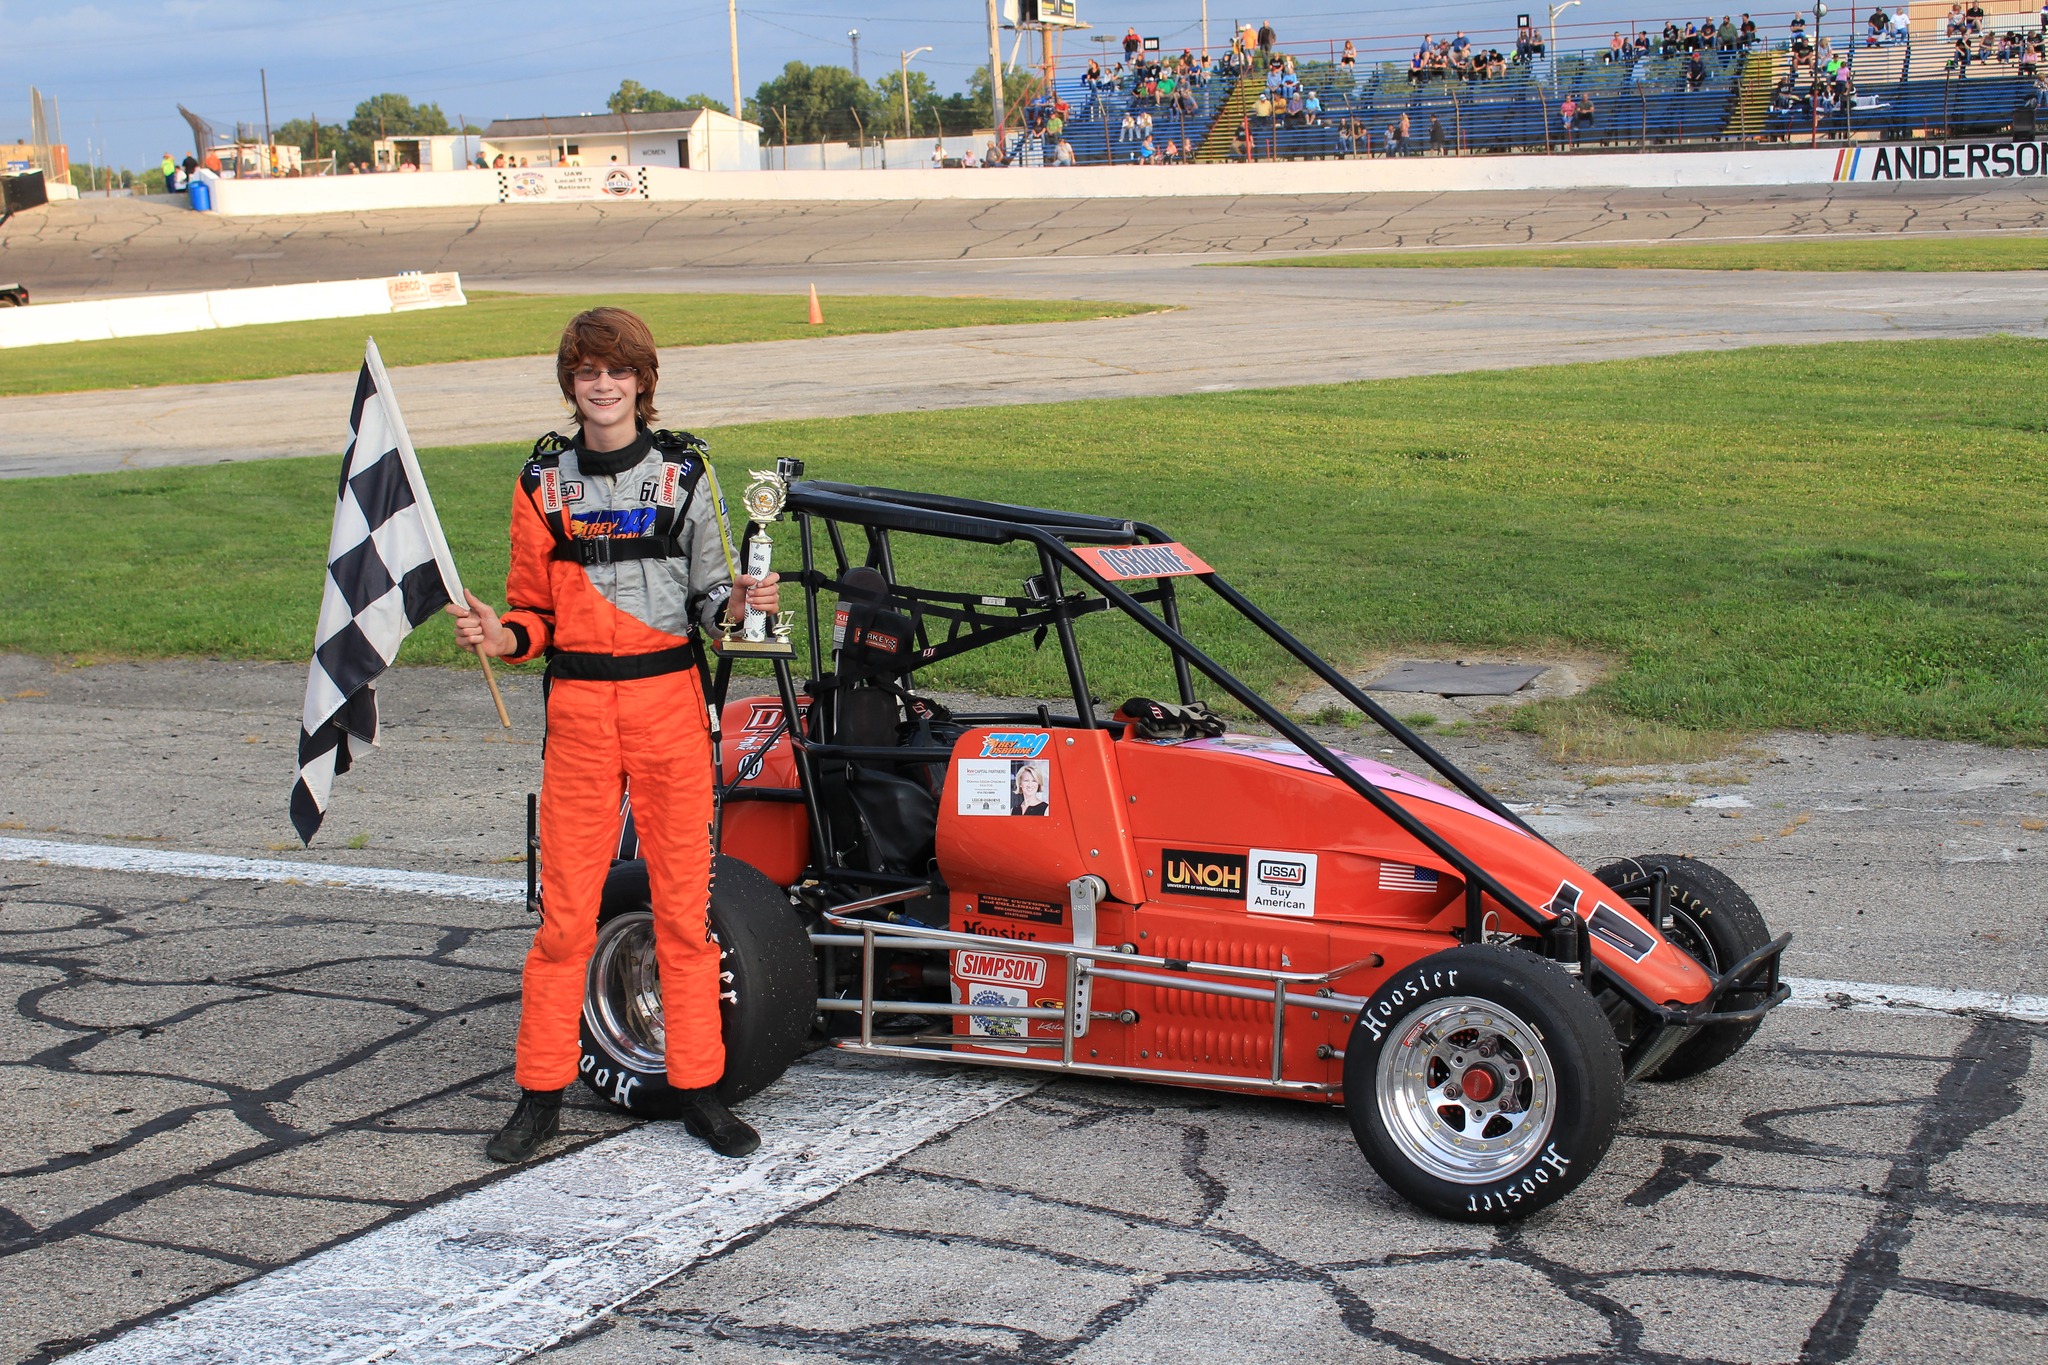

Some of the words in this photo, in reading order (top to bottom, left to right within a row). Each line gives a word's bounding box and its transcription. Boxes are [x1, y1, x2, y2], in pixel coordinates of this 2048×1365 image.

[545, 472, 557, 507] SIMPSON
[663, 466, 676, 503] SIMPSON
[582, 522, 618, 536] TREY
[1097, 546, 1193, 577] OSBORNE
[1167, 860, 1241, 888] UNOH
[1264, 866, 1297, 878] USSA
[1254, 896, 1306, 909] American
[1270, 886, 1291, 899] Buy
[962, 954, 1038, 981] SIMPSON
[1360, 969, 1459, 1041] Hoosier
[1466, 1143, 1572, 1213] Hoosier
